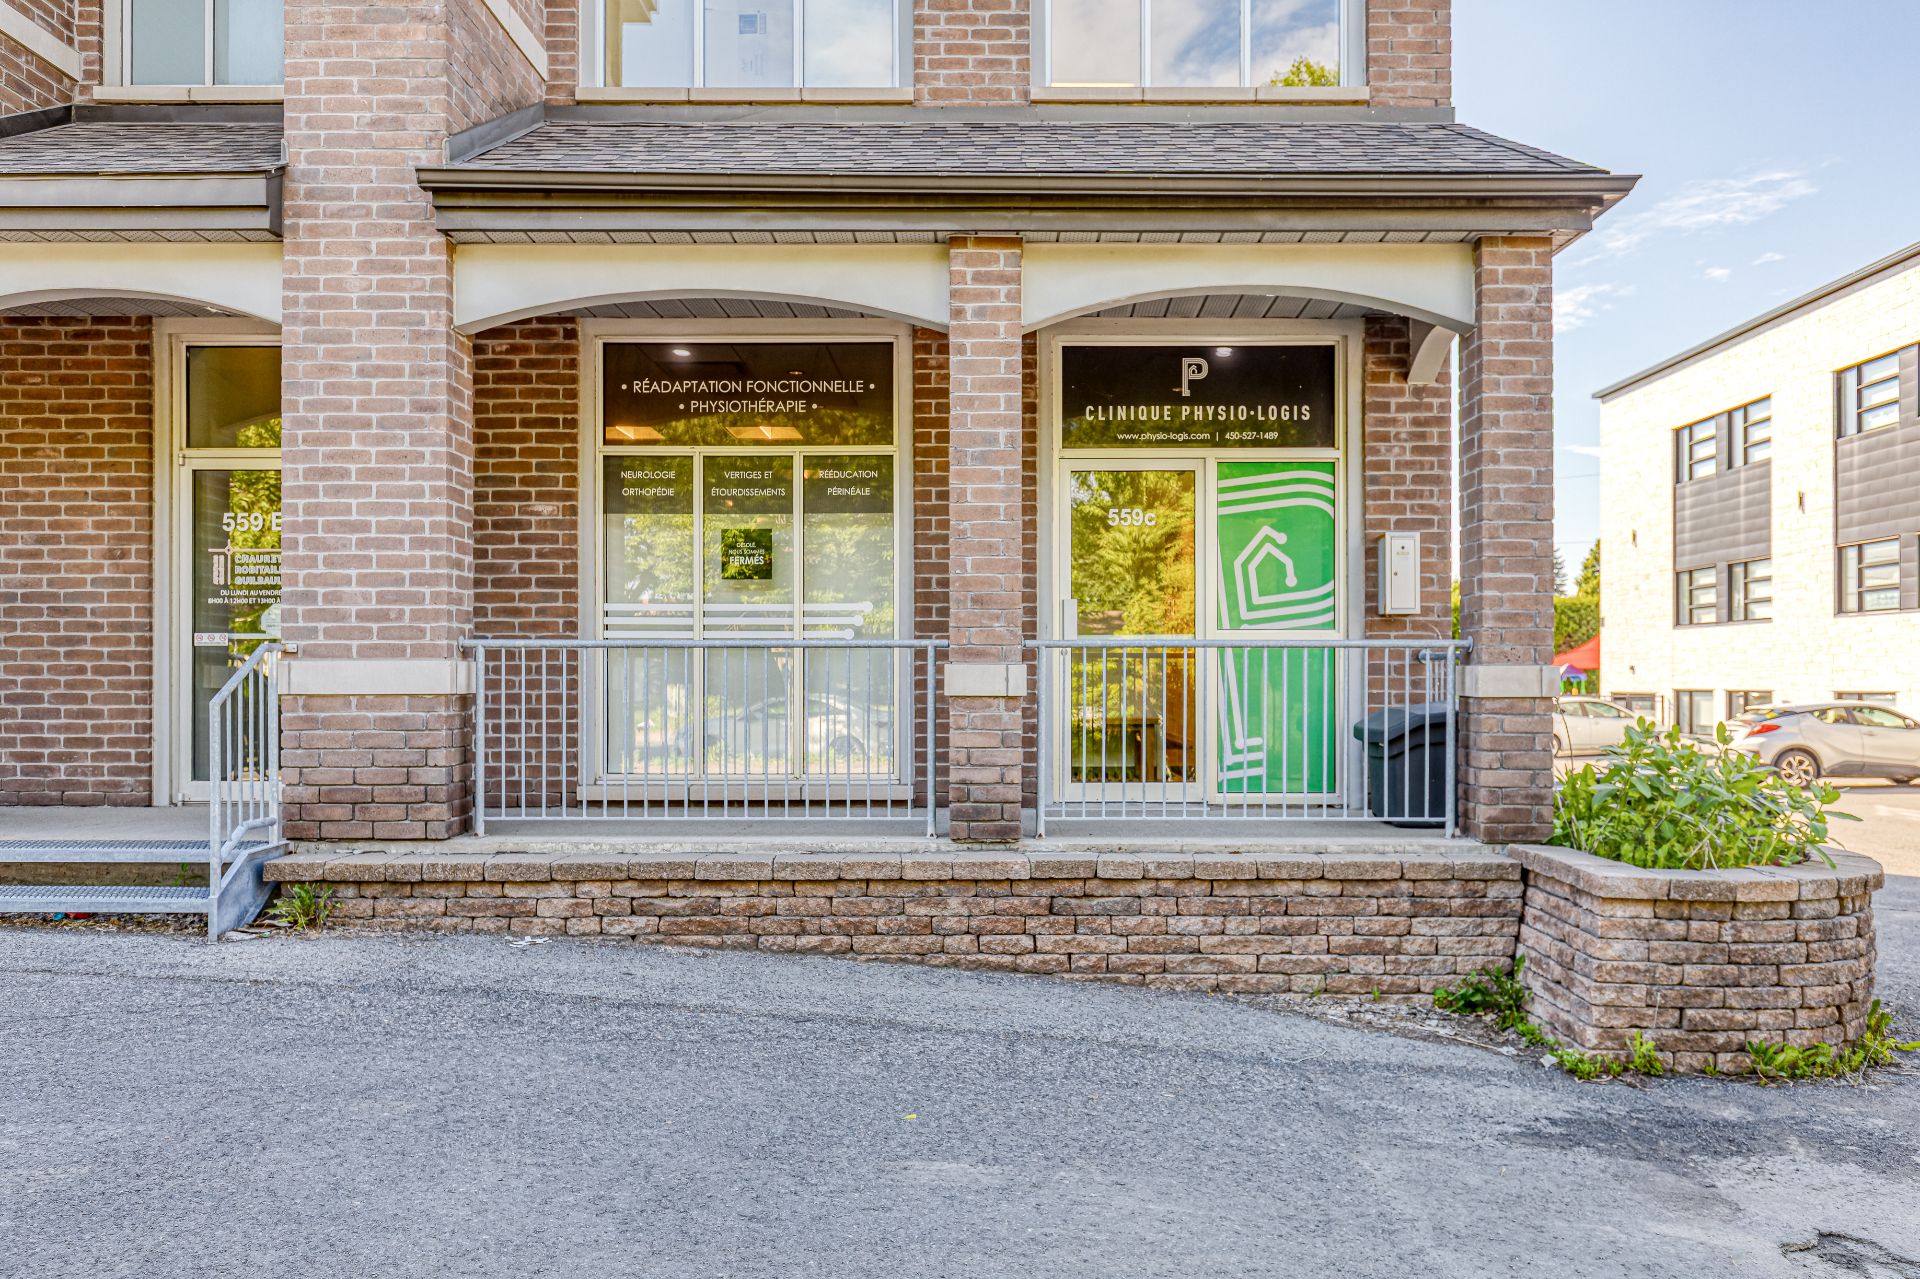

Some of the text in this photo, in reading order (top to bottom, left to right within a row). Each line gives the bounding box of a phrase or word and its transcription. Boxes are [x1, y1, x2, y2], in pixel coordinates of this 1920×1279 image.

[633, 377, 864, 393] RÉADAPTATION FONCTIONNELLE
[690, 397, 807, 413] PHYSIOTHÉRAPIE
[1085, 405, 1172, 421] CLINIQUE
[1116, 431, 1279, 441] www.physio-logis.com 450-527-1489
[620, 470, 676, 479] NEUROLOGIE
[724, 470, 773, 479] VERTIGES ET
[819, 467, 878, 478] RÉÉDUCATION
[621, 485, 675, 496] ORTHOPÉDIE
[711, 485, 786, 496] ÉTOURDISSEMENTS
[827, 484, 871, 496] PÉRINÉALE
[222, 512, 263, 531] 559
[1107, 508, 1157, 526] 559c
[729, 554, 764, 564] FERMÉS
